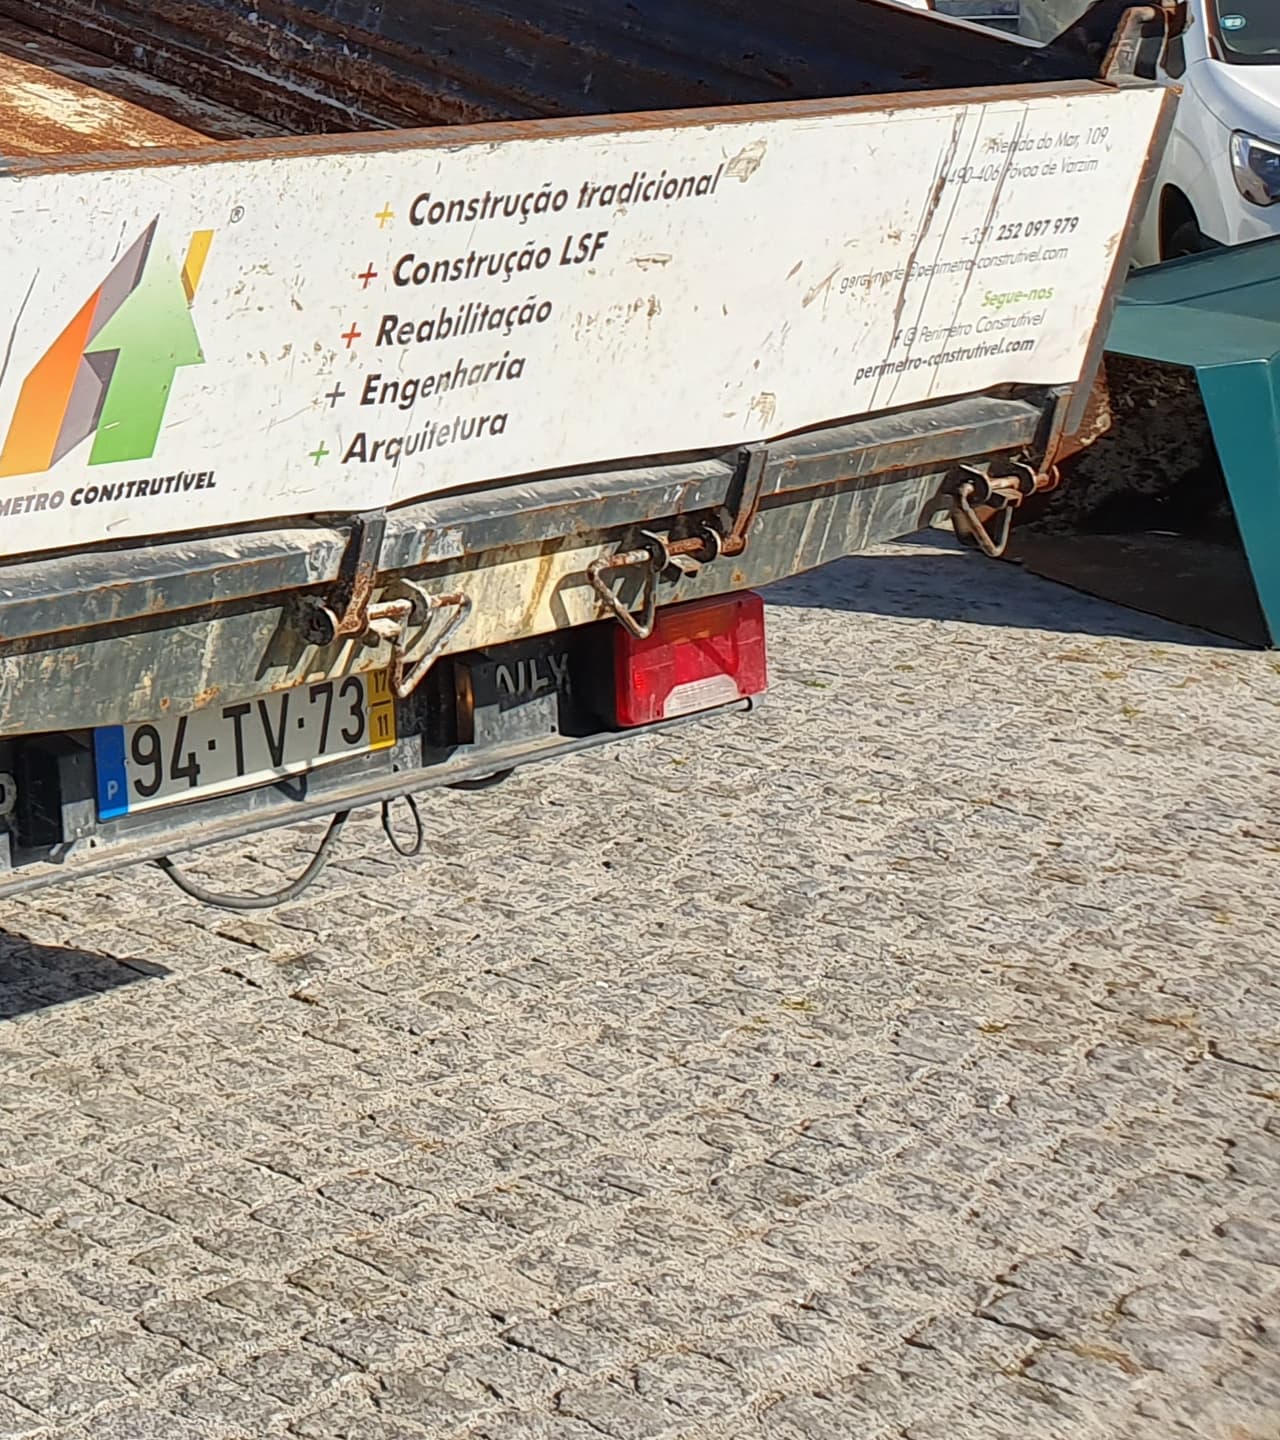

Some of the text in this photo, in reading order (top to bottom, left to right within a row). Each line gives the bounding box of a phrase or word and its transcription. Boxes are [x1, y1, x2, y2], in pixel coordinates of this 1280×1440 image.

[1036, 133, 1053, 150] do
[1086, 126, 1109, 146] 109
[1041, 160, 1057, 176] de
[409, 163, 726, 226] Construção tradicional
[996, 222, 1023, 241] 252
[1024, 219, 1052, 238] 097
[1052, 216, 1080, 235] 979
[392, 230, 608, 287] Construção LSF
[981, 286, 1054, 310] Segue-nos
[375, 295, 553, 347] Reabilitação
[359, 350, 527, 410] Engenharia
[341, 410, 509, 468] Arquitetura
[70, 470, 217, 506] CONSTRUTÍVEL
[372, 668, 389, 694] 17
[105, 781, 120, 801] P
